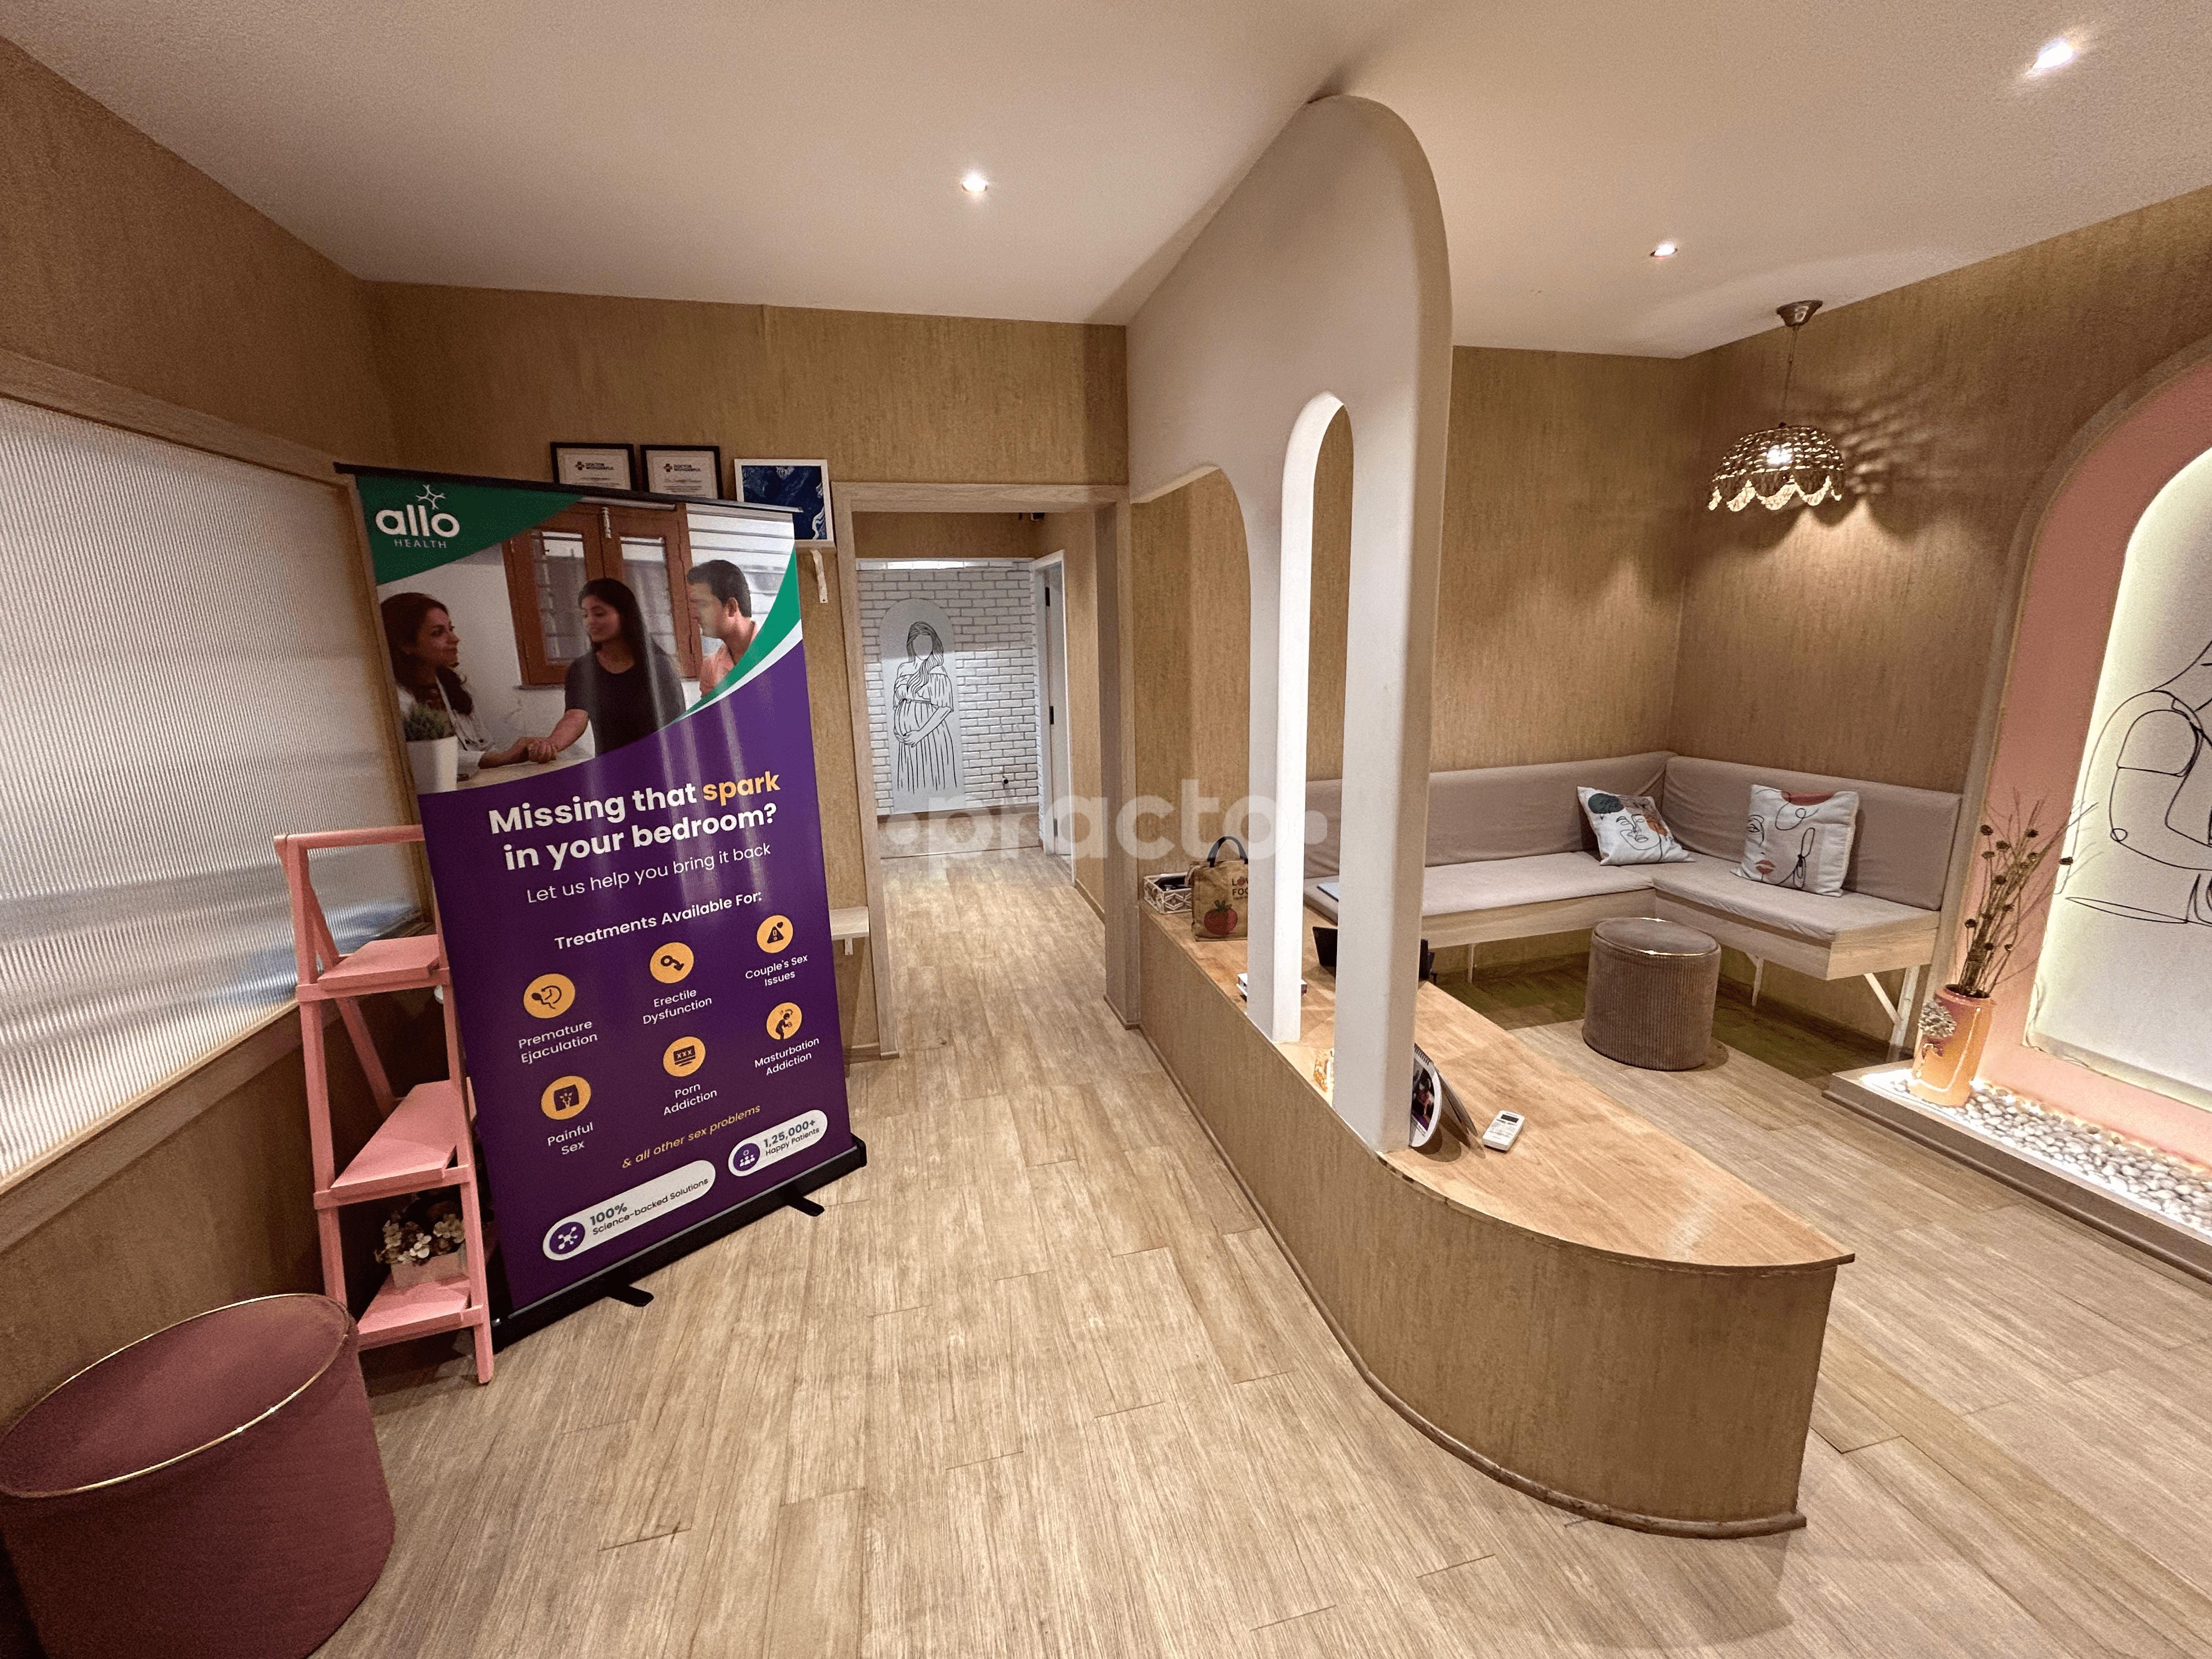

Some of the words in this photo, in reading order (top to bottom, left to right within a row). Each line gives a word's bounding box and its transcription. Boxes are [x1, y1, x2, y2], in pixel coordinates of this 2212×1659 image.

[376, 505, 460, 537] allo
[394, 539, 446, 548] HEALTH
[489, 797, 625, 834] Missing
[632, 783, 697, 811] that
[703, 771, 780, 805] spark
[504, 845, 539, 870] in
[546, 832, 624, 871] your
[632, 803, 776, 847] bedroom?
[527, 886, 557, 902] Let
[563, 882, 584, 895] us
[590, 872, 629, 890] help
[635, 866, 668, 885] you
[673, 856, 714, 873] bring
[719, 851, 729, 864] it
[733, 843, 770, 860] back
[555, 917, 657, 949] Treatments
[662, 899, 732, 924] Available
[736, 892, 762, 905] For:
[746, 961, 789, 978] Couple's
[792, 955, 807, 965] Sex
[765, 972, 795, 986] Issues
[643, 998, 712, 1024] Dysfunction
[654, 990, 696, 1007] Erectile
[519, 1022, 592, 1048] Premature
[521, 1034, 597, 1064] Ejaculation
[755, 1039, 819, 1068] Masturbation
[766, 1053, 811, 1075] Addiction
[664, 1091, 716, 1115] Addiction
[675, 1084, 700, 1098] Porn
[548, 1122, 593, 1146] Painful
[623, 1158, 631, 1168] &
[636, 1149, 650, 1162] all
[654, 1137, 684, 1154] other
[689, 1128, 706, 1141] sex
[710, 1106, 760, 1135] problems
[764, 1119, 816, 1147] 1,25,000+
[765, 1142, 789, 1156] Happy
[792, 1127, 820, 1144] Patients
[562, 1141, 584, 1154] Sex
[591, 1203, 627, 1226] 100%
[593, 1196, 668, 1234] Science-backed
[670, 1178, 708, 1200] Solutions
